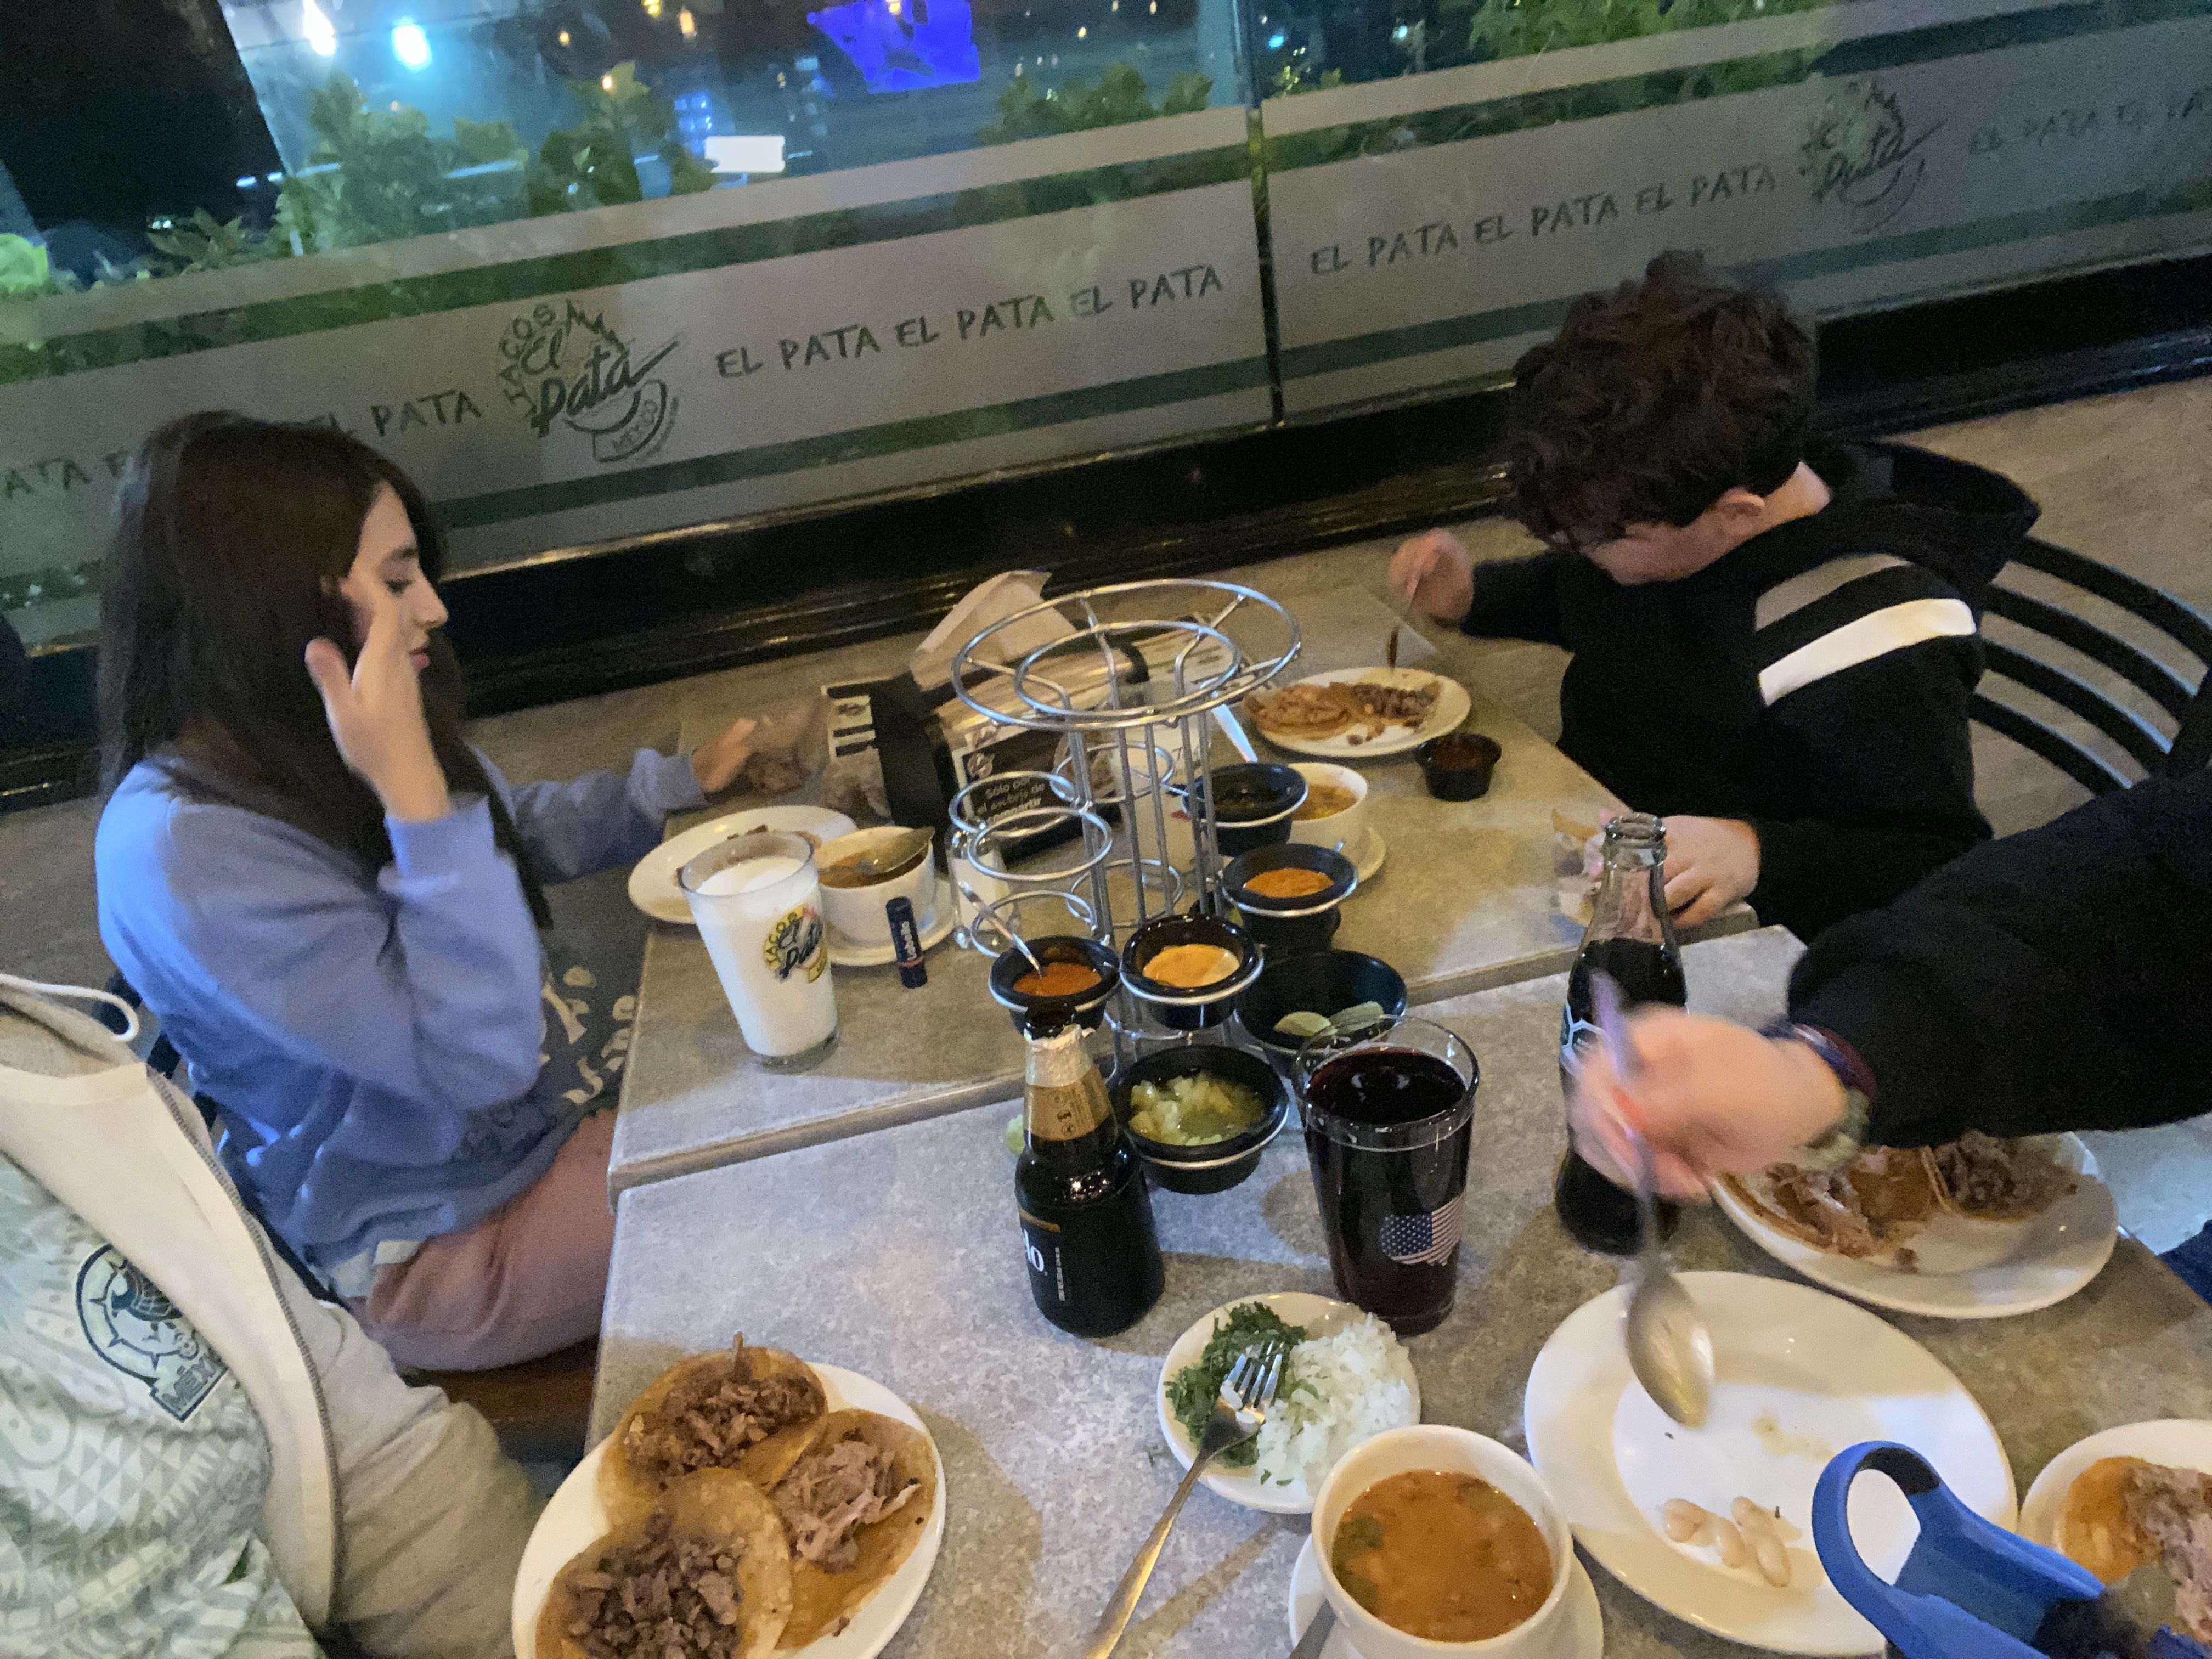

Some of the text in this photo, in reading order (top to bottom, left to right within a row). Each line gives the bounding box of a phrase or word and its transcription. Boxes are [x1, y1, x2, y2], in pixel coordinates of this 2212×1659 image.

[1310, 163, 1777, 275] EL PATA EL PATA EL PATA
[715, 264, 1223, 379] EL PATA EL PATA EL PATA
[370, 388, 482, 437] PATA
